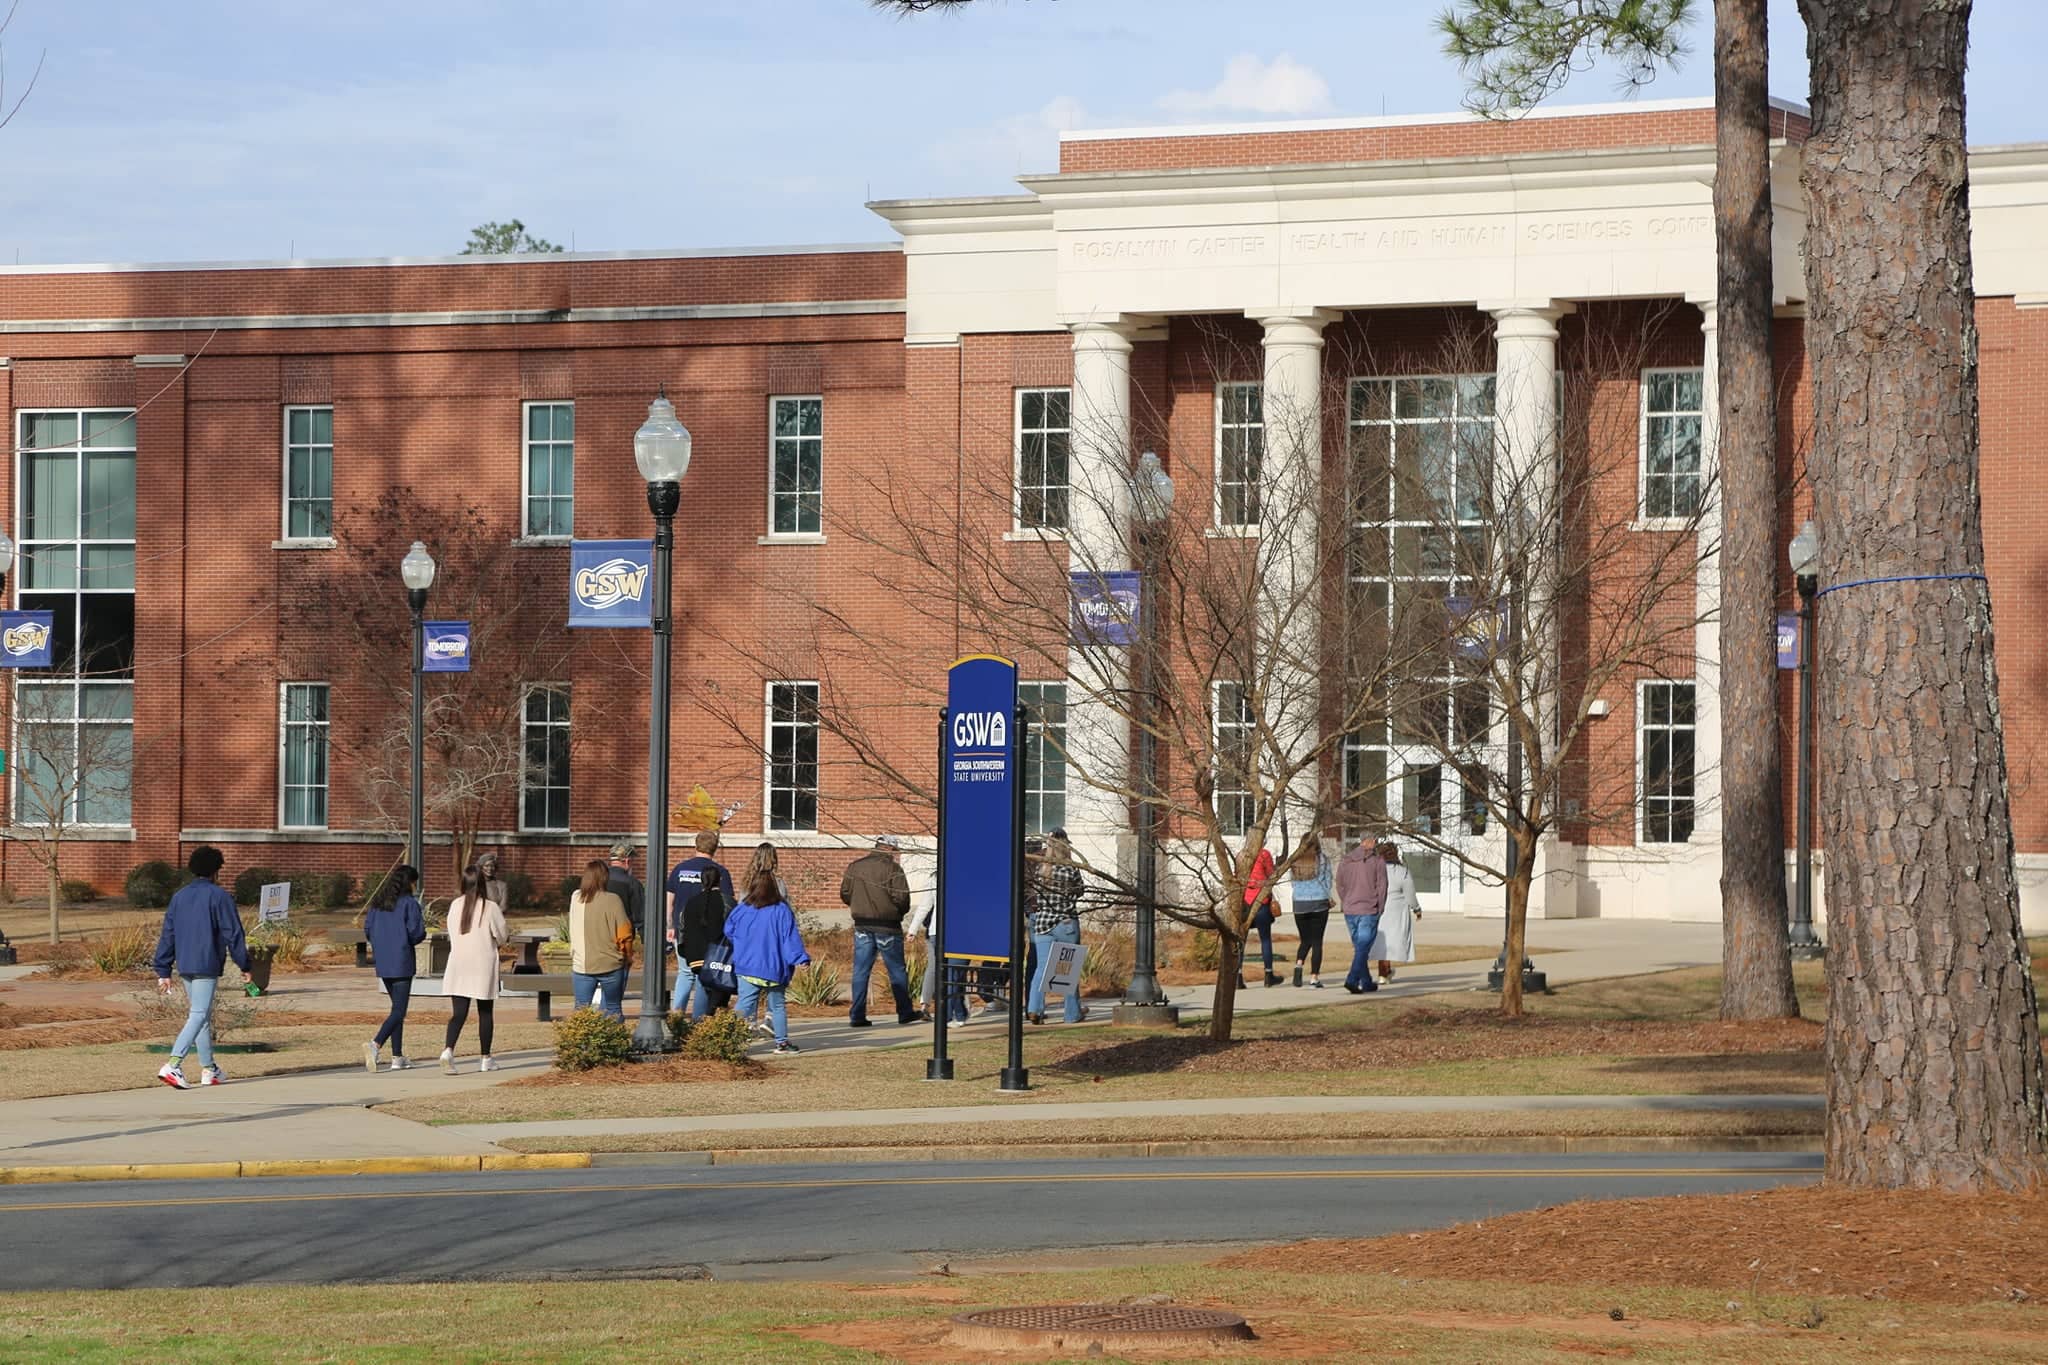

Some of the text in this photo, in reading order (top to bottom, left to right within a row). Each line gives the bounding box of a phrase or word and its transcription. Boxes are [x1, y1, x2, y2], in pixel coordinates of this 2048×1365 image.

[1072, 239, 1177, 257] ROSALYNN
[1186, 236, 1265, 256] CARTER
[1290, 231, 1367, 252] HEALTH
[1376, 229, 1421, 248] AND
[1431, 225, 1507, 248] HUMAN
[1527, 219, 1633, 241] SCIENCES
[576, 568, 647, 600] GSW
[5, 629, 49, 649] GSW
[954, 711, 991, 748] GSW
[953, 771, 1005, 782] STATE UNIVERSITY
[1059, 946, 1076, 962] EXIT
